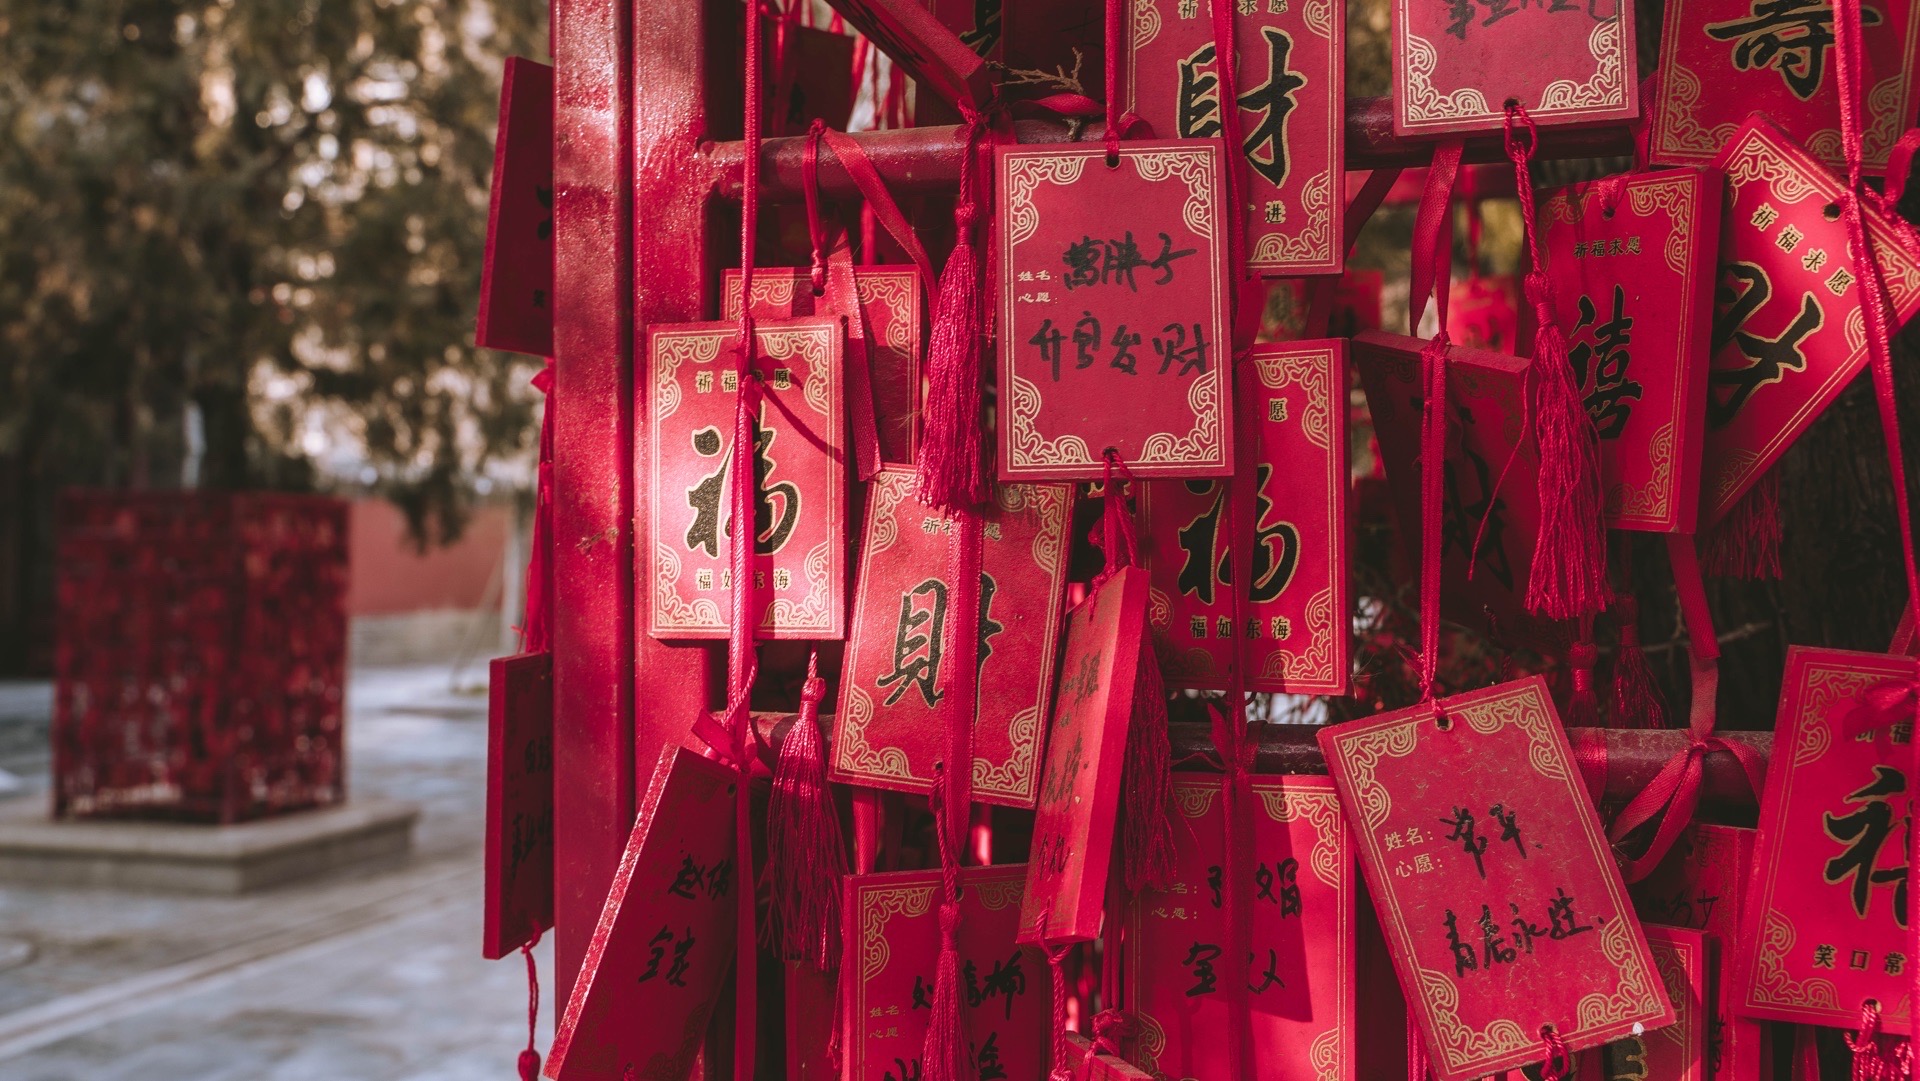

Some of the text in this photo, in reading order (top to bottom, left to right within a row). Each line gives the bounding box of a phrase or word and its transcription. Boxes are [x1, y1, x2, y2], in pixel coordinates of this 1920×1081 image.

[1177, 0, 1285, 19] 祈求愿
[1572, 236, 1643, 258] 祈福求愿
[1749, 203, 1856, 297] 祈福求愿
[685, 400, 801, 559] 福
[921, 516, 1003, 542] 祈愿
[1384, 825, 1434, 852] 姓名：
[1395, 853, 1444, 879] 心愿：
